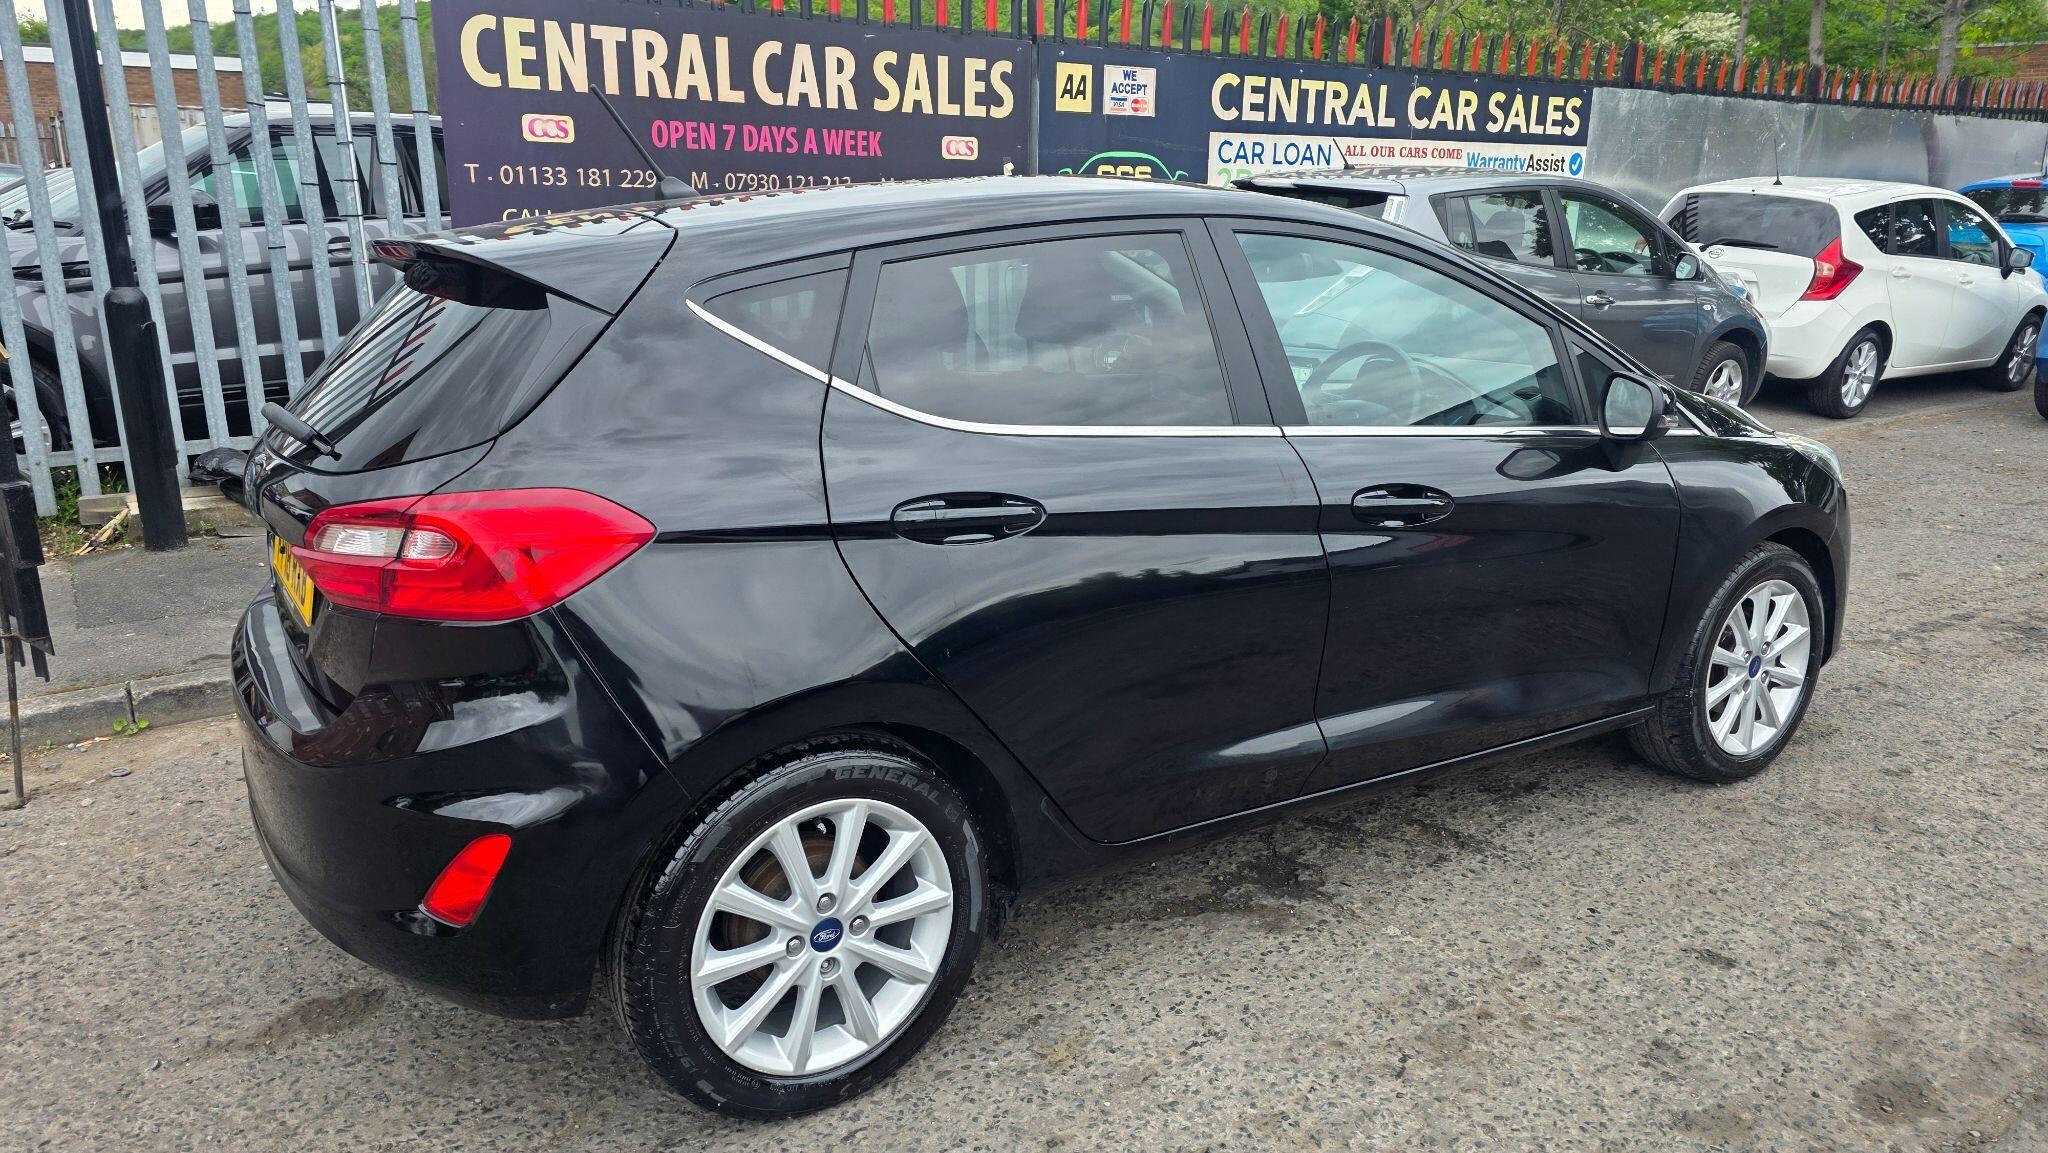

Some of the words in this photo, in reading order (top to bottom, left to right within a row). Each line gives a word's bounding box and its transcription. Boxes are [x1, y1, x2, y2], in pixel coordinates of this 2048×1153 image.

[461, 14, 745, 103] CENTRAL
[752, 40, 858, 110] CAR
[873, 50, 1014, 118] SALES
[1123, 70, 1137, 81] WE
[1060, 74, 1087, 100] AA
[1111, 82, 1148, 95] ACCEPT
[1211, 72, 1396, 127] CENTRAL
[1407, 86, 1476, 132] CAR
[1485, 91, 1583, 137] SALES
[528, 118, 569, 139] CCS
[651, 119, 716, 150] OPEN
[722, 124, 736, 150] 7
[743, 124, 799, 153] DAYS
[803, 128, 819, 155] A
[822, 128, 883, 157] WEEK
[946, 140, 975, 156] CCS
[1217, 140, 1264, 165] CAR
[1272, 142, 1331, 166] LOAN
[1344, 145, 1366, 157] ALL
[1370, 146, 1395, 157] OUR
[1399, 146, 1428, 158] CARS
[1431, 148, 1463, 159] COME
[500, 164, 568, 186] 01133
[576, 168, 610, 187] 181
[619, 169, 657, 188] 229
[724, 172, 780, 191] 07930
[835, 764, 941, 805] GENERAL
[816, 929, 838, 942] Ford
